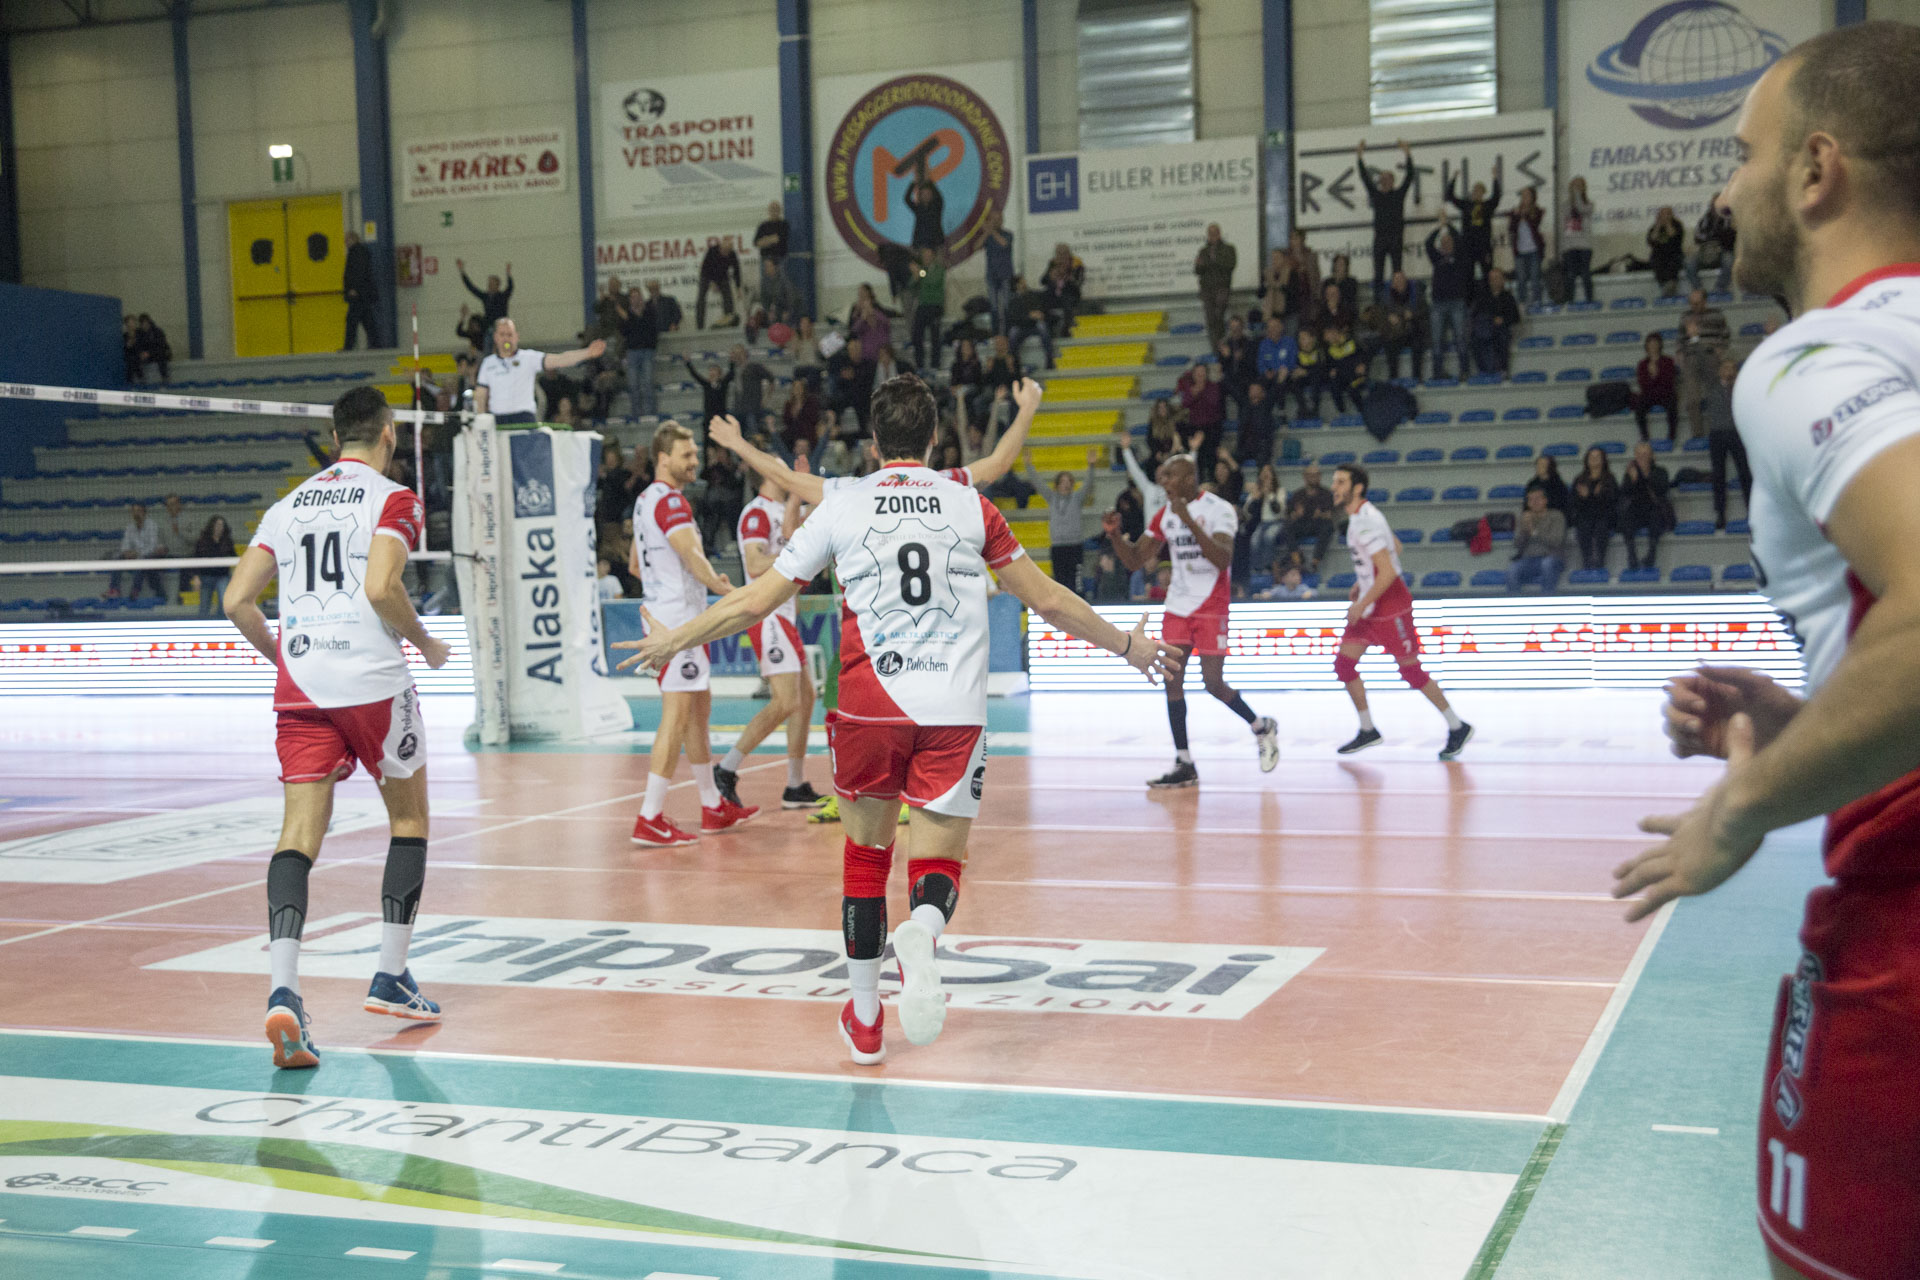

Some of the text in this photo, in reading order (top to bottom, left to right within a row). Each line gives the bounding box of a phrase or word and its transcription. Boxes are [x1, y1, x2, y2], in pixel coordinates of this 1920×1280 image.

[622, 114, 754, 141] TRASPORTI
[622, 137, 754, 168] VERDOLINI
[1590, 140, 1694, 168] EMBASSY
[1087, 157, 1254, 193] EULER HERMES
[1608, 166, 1703, 192] SERVICES
[293, 487, 365, 508] BENAGLIA
[874, 496, 942, 515] ZONCA
[301, 531, 344, 591] 14
[898, 542, 931, 606] 8
[521, 527, 563, 684] Alaska
[906, 656, 948, 672] Polochem
[195, 1096, 1078, 1182] ChiantiBanca
[1768, 1137, 1807, 1230] 11
